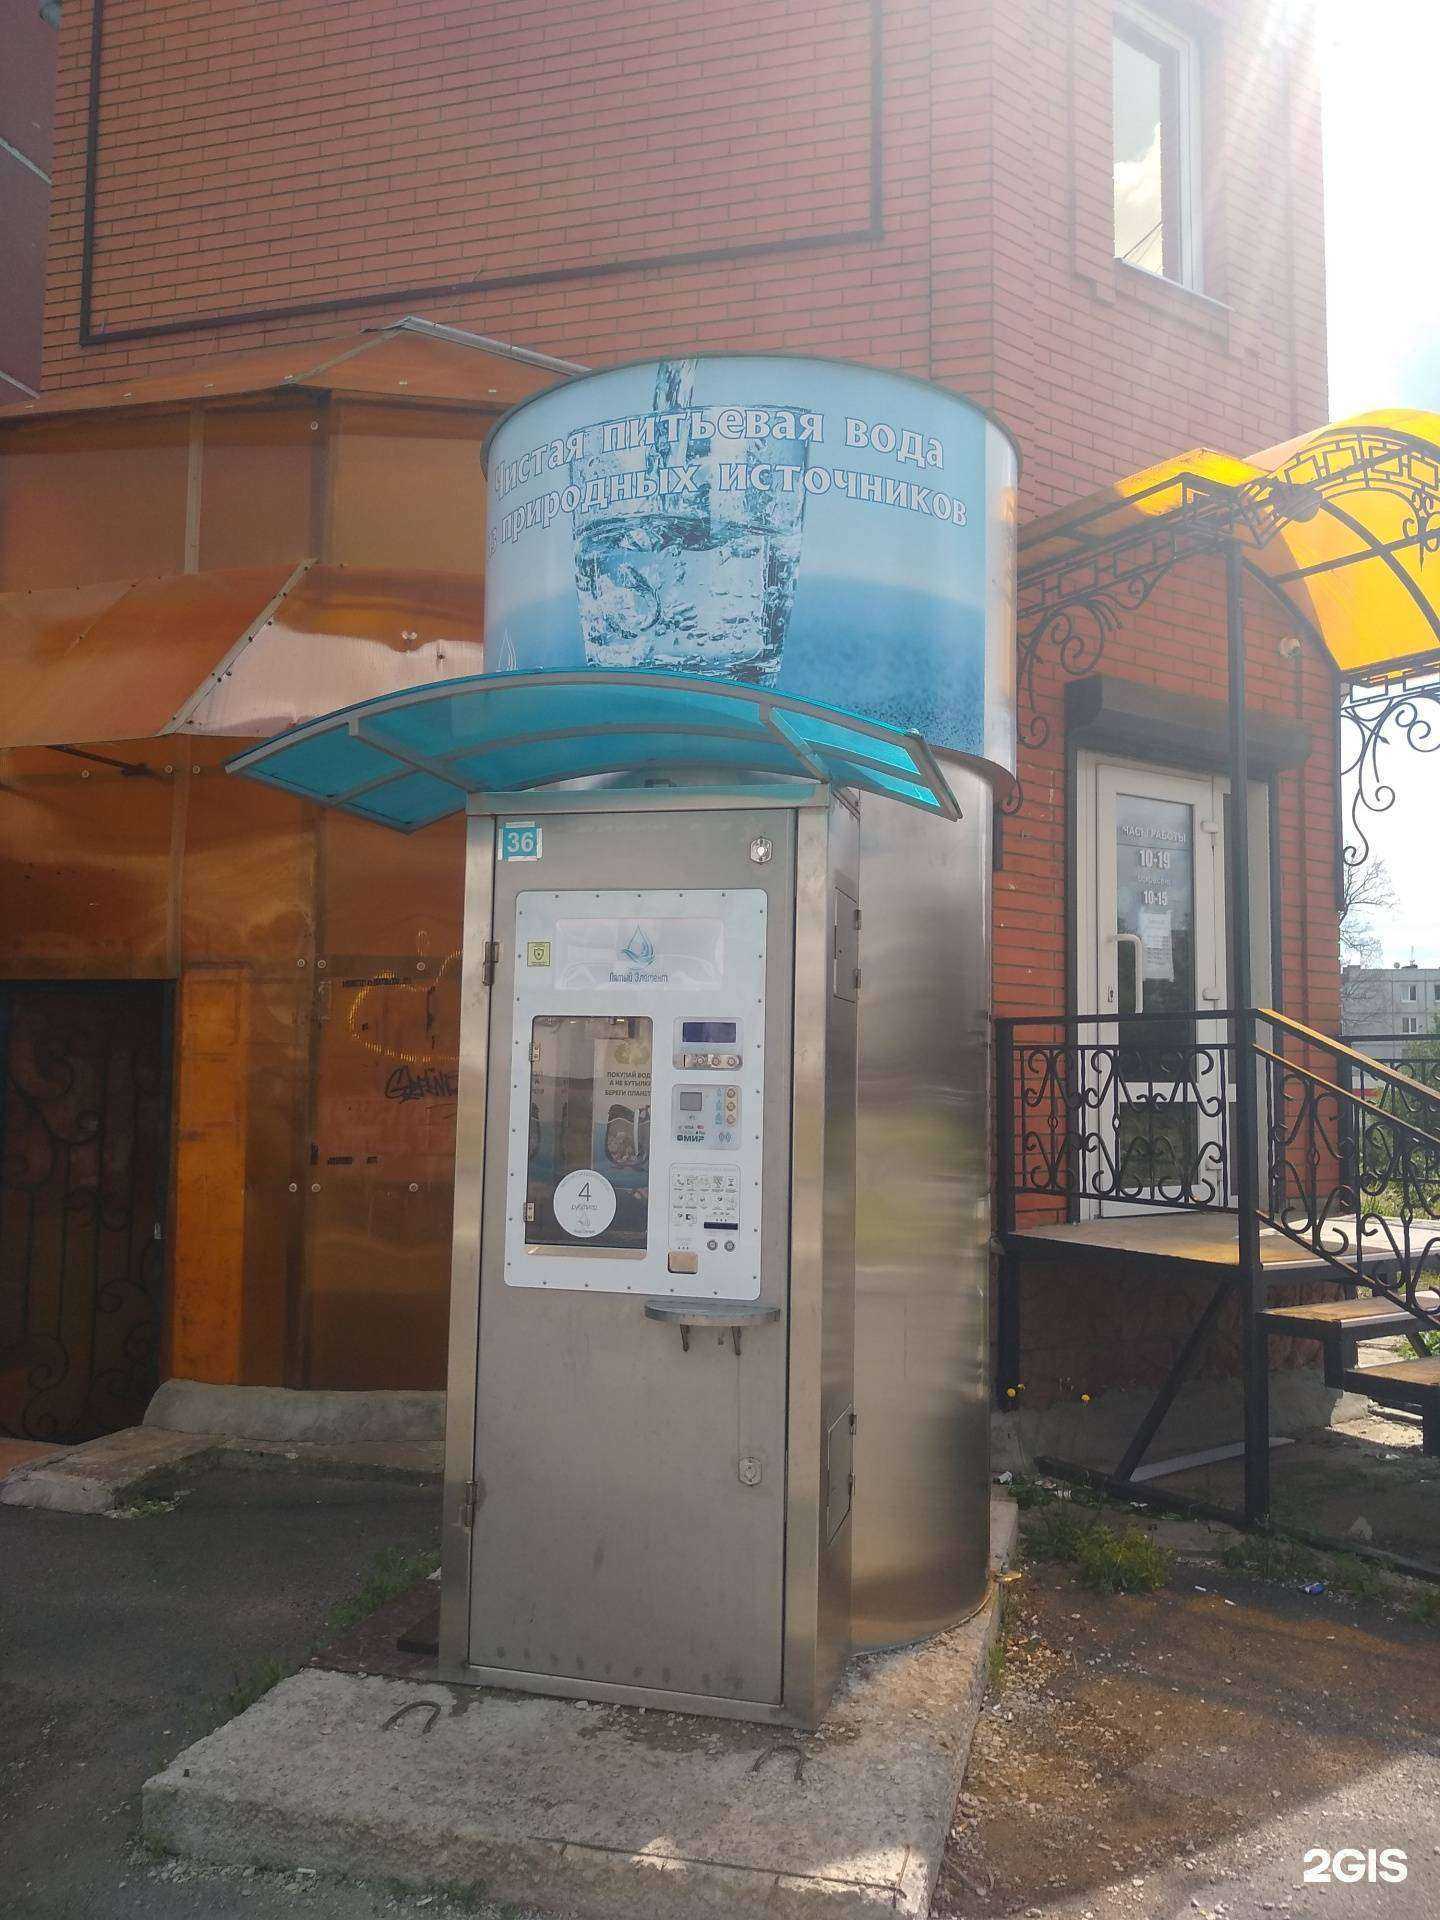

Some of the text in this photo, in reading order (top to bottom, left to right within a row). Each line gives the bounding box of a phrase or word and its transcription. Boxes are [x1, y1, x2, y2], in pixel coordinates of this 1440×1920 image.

[495, 409, 945, 501] Чистая питьевая вода
[501, 463, 700, 544] природных
[719, 462, 968, 528] источников
[507, 832, 534, 853] 36
[1140, 848, 1171, 869] 10-19
[1143, 889, 1168, 906] 10-15
[637, 1071, 651, 1079] ВОД
[578, 1182, 592, 1202] 4
